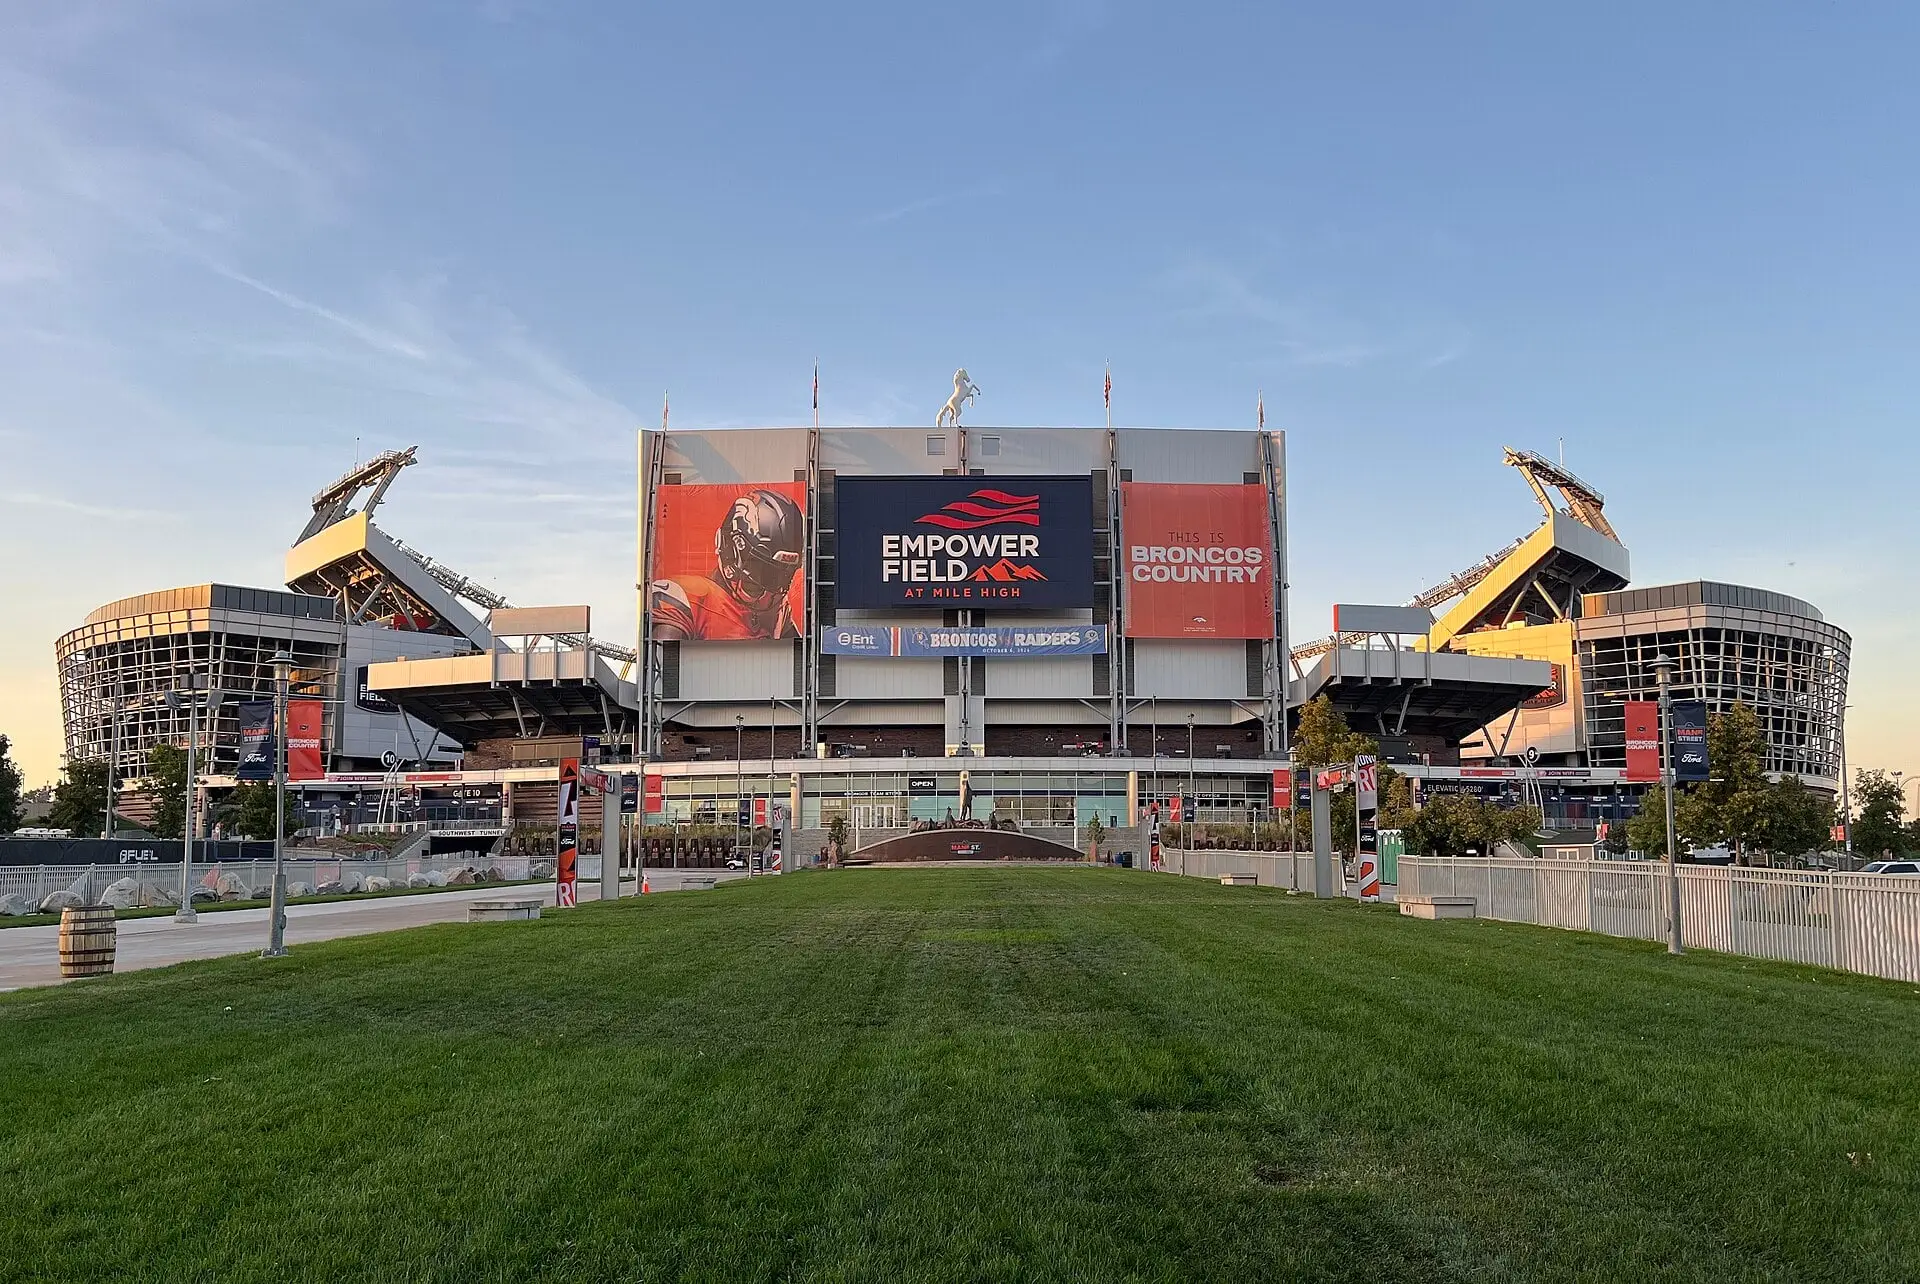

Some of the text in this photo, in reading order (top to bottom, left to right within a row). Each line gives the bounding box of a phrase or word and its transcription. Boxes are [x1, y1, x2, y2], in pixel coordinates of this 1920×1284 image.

[1168, 532, 1224, 543] THIS IS
[882, 535, 1039, 557] EMPOWER
[1131, 546, 1262, 564] BRONCOS
[882, 559, 968, 582] FIELD
[1132, 565, 1262, 583] COUNTRY
[904, 588, 1020, 598] AT MILE HIGH
[852, 634, 875, 645] Ent
[930, 633, 996, 647] BRONCOS
[1014, 632, 1080, 646] RAIDERS
[244, 753, 267, 763] Ford
[385, 754, 395, 764] 10
[1681, 753, 1703, 763] Ford
[472, 789, 480, 797] 10
[1427, 785, 1459, 793] ELEVATIO
